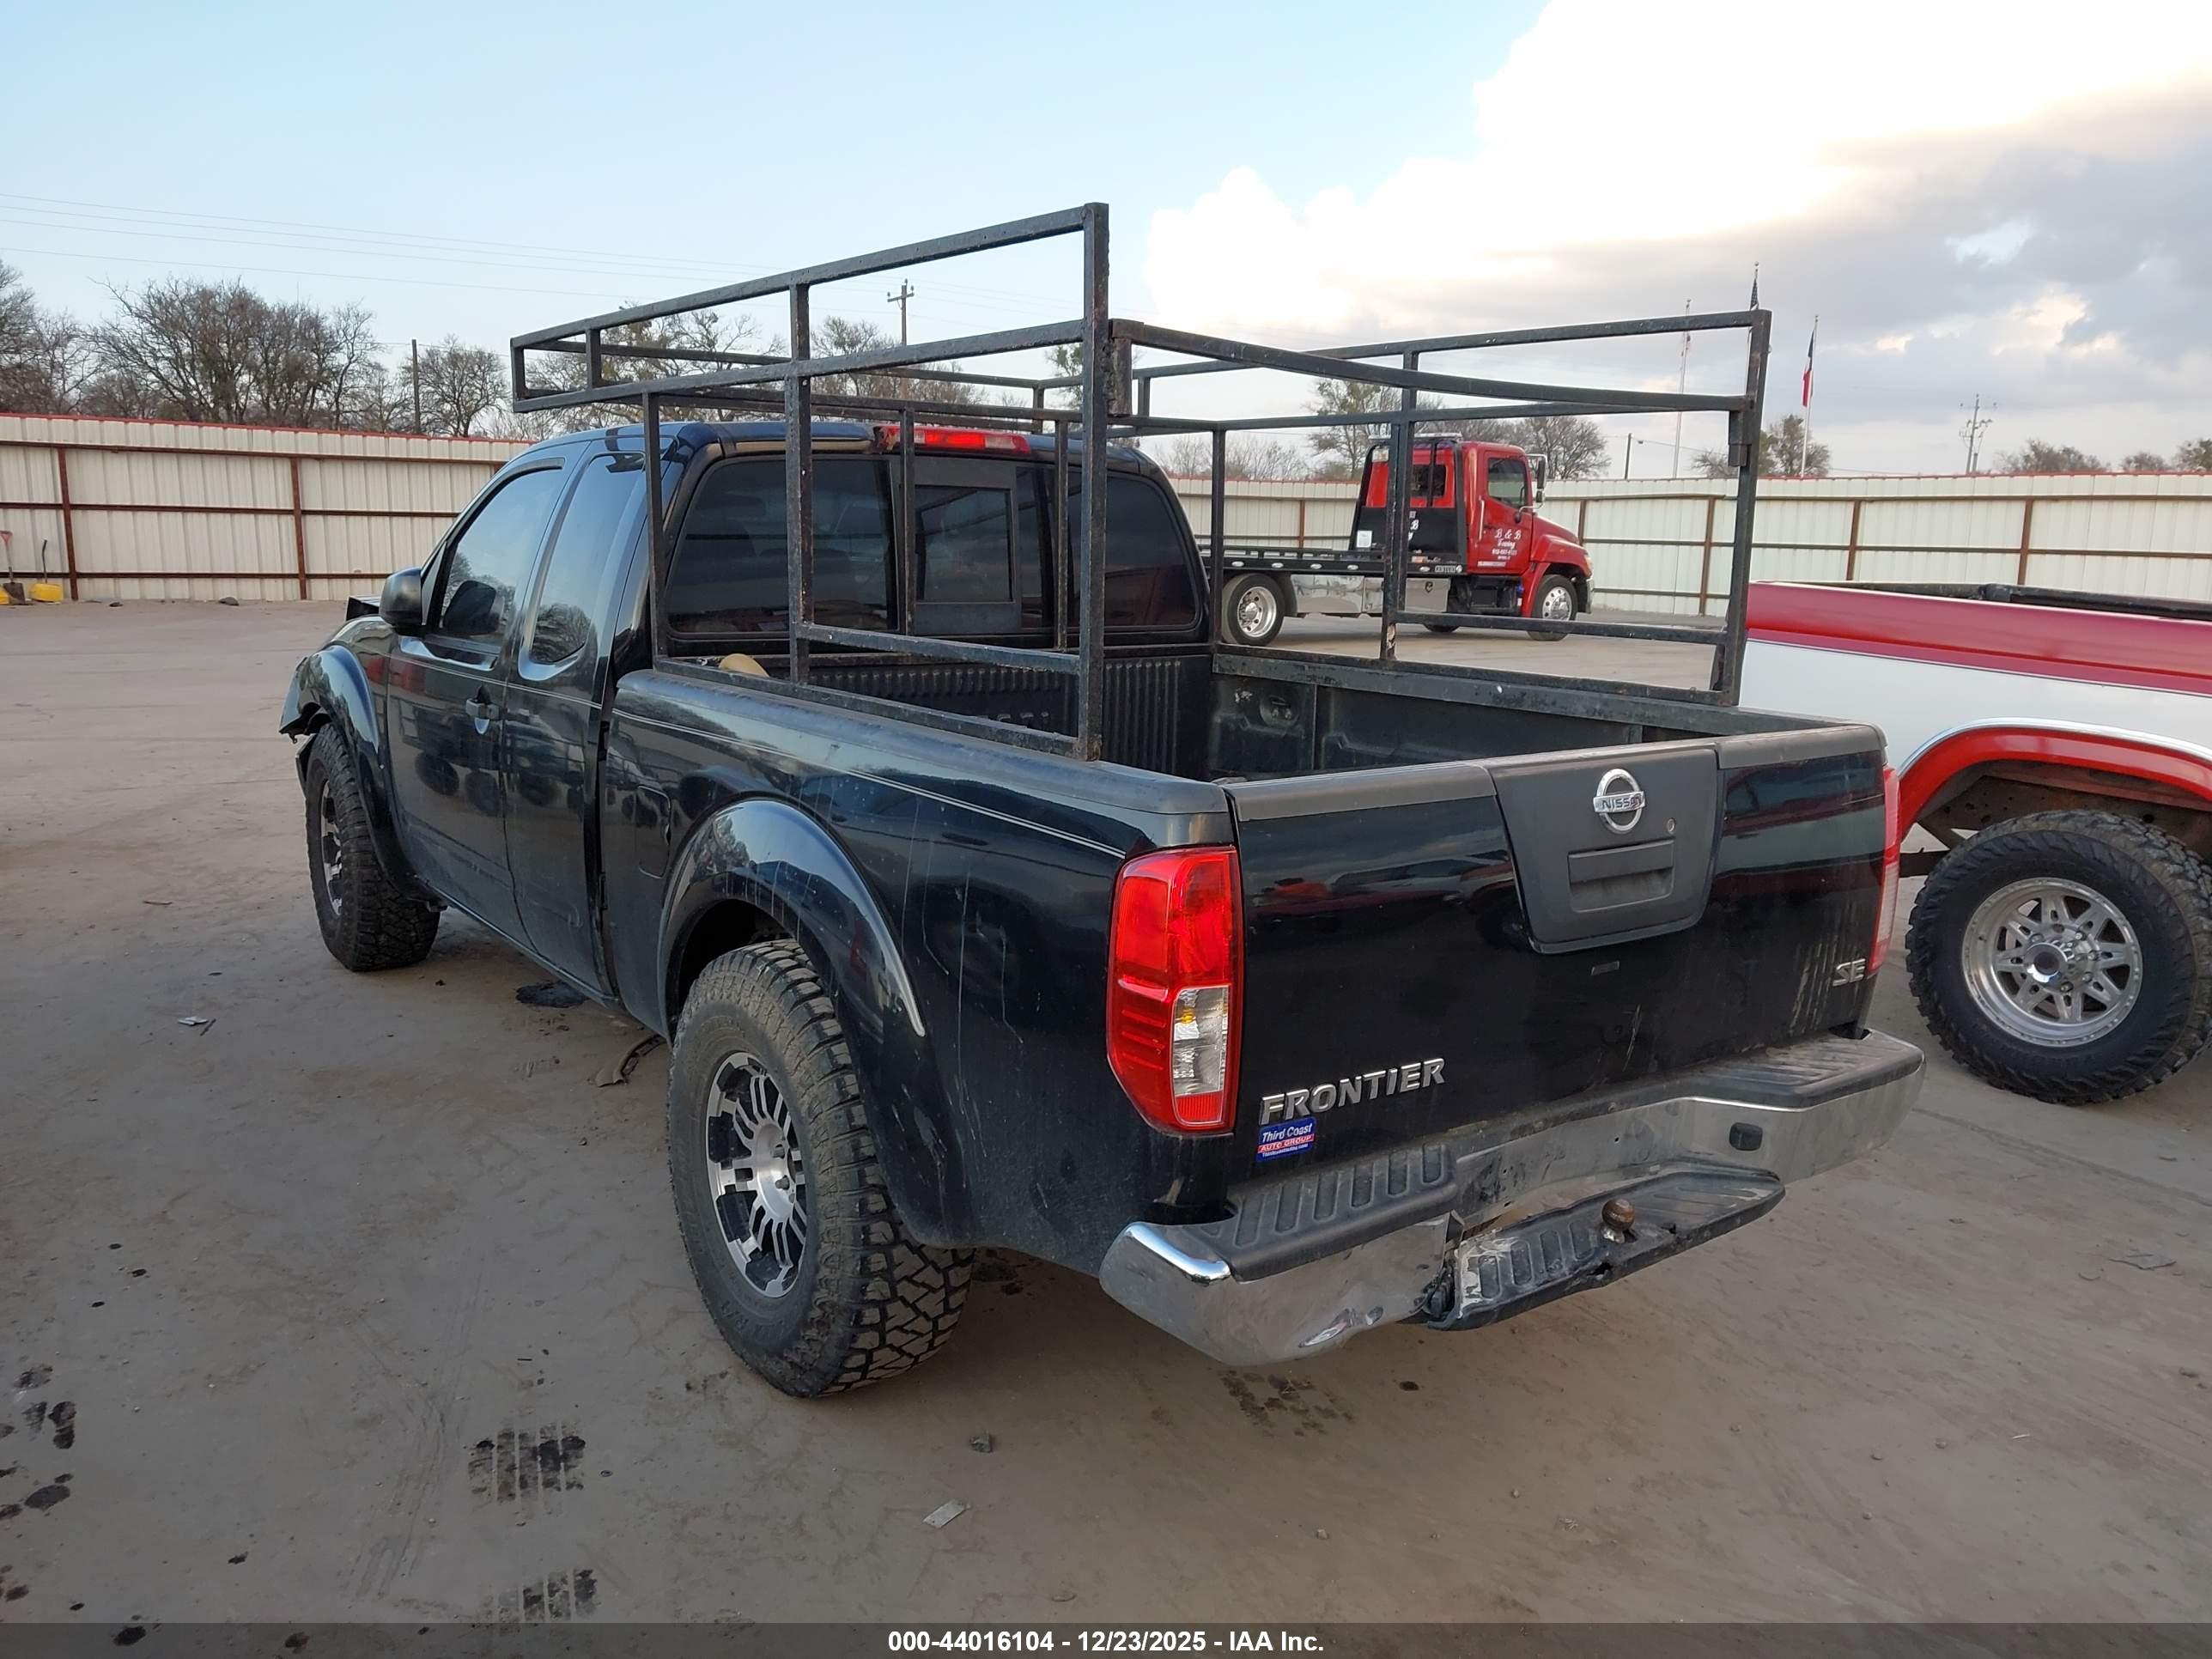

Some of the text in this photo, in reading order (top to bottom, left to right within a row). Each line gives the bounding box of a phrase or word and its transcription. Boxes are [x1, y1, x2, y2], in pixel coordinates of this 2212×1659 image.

[1504, 528, 1512, 539] &
[1601, 793, 1642, 810] NISSAN
[1832, 957, 1866, 987] SE
[1259, 1057, 1445, 1126] FRONTIER
[1262, 1122, 1313, 1143] Third Coast
[1259, 1141, 1283, 1152] AUTO
[1284, 1135, 1312, 1146] GROUP
